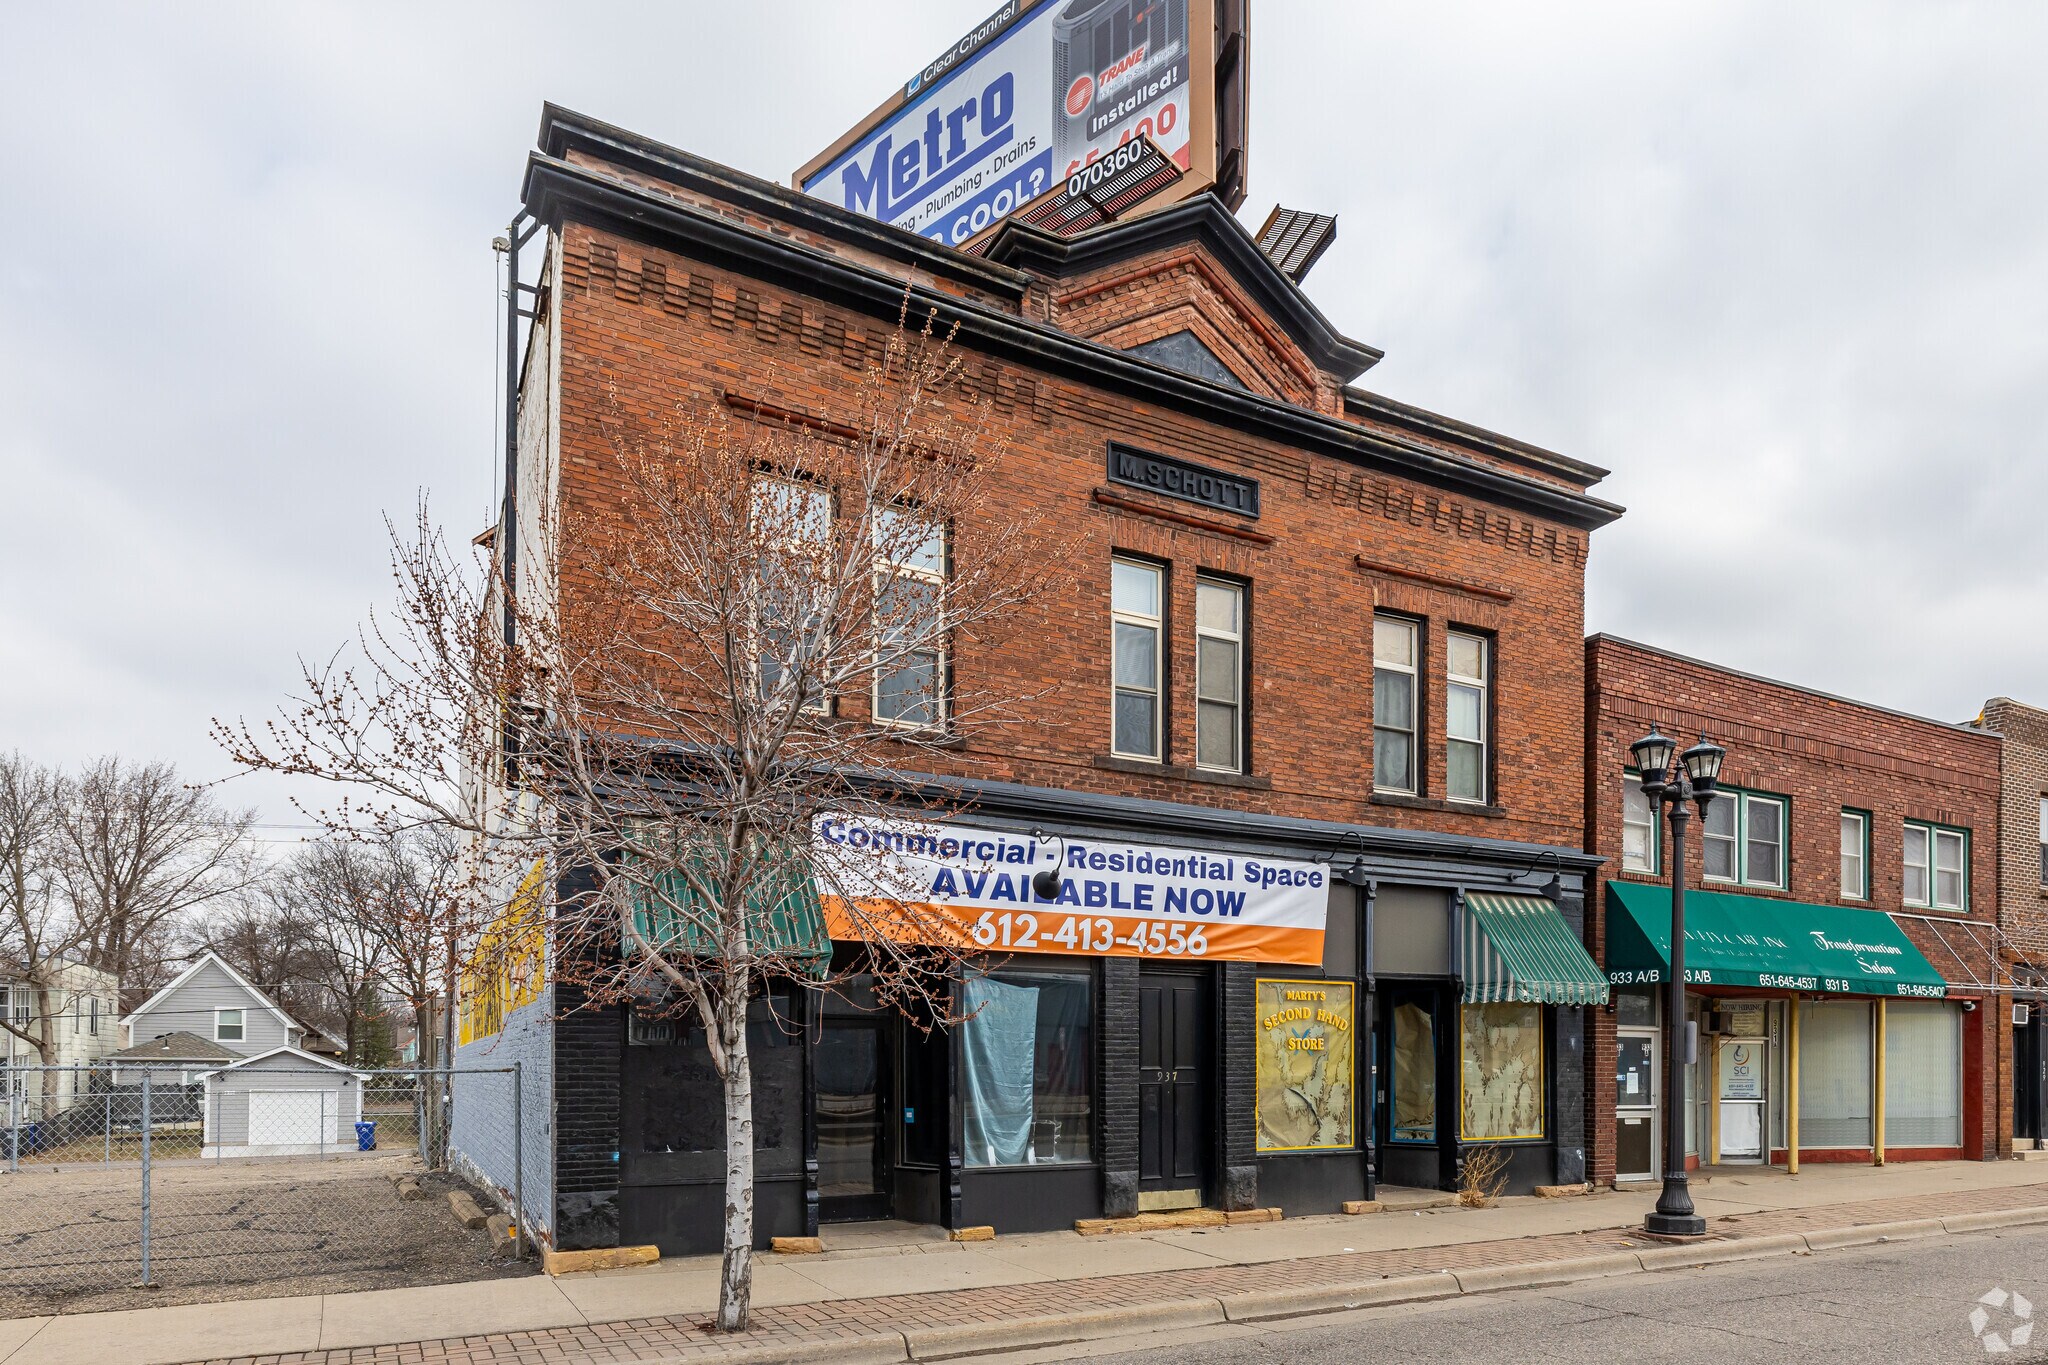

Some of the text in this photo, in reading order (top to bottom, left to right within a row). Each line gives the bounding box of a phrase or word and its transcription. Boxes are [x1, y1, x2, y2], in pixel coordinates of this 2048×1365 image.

[923, 0, 1016, 82] Clear Channel
[1099, 46, 1145, 88] TRANE
[1092, 66, 1178, 133] Installed!
[841, 72, 1014, 222] Metro
[926, 171, 982, 218] Plumbing
[993, 135, 1036, 174] Drains
[1068, 139, 1142, 198] 070360
[951, 167, 1045, 244] COOL?
[821, 818, 1036, 865] Commercial
[1068, 845, 1234, 881] Residential
[1244, 861, 1323, 890] Space
[1163, 886, 1247, 917] NOW
[972, 911, 1208, 956] 612-413-4556
[1809, 931, 1902, 956] Transformation
[1610, 970, 1660, 984] 933 A/B
[1694, 969, 1711, 983] A/B
[1857, 957, 1896, 975] Salon
[1759, 974, 1817, 989] 651-645-4537
[1825, 978, 1849, 991] 931 B
[1286, 990, 1326, 1001] MARTY'S
[1263, 1007, 1349, 1031] SECOND HAND
[1288, 1037, 1325, 1051] STORE
[1157, 1071, 1178, 1082] 937
[1733, 1066, 1750, 1075] SCI
